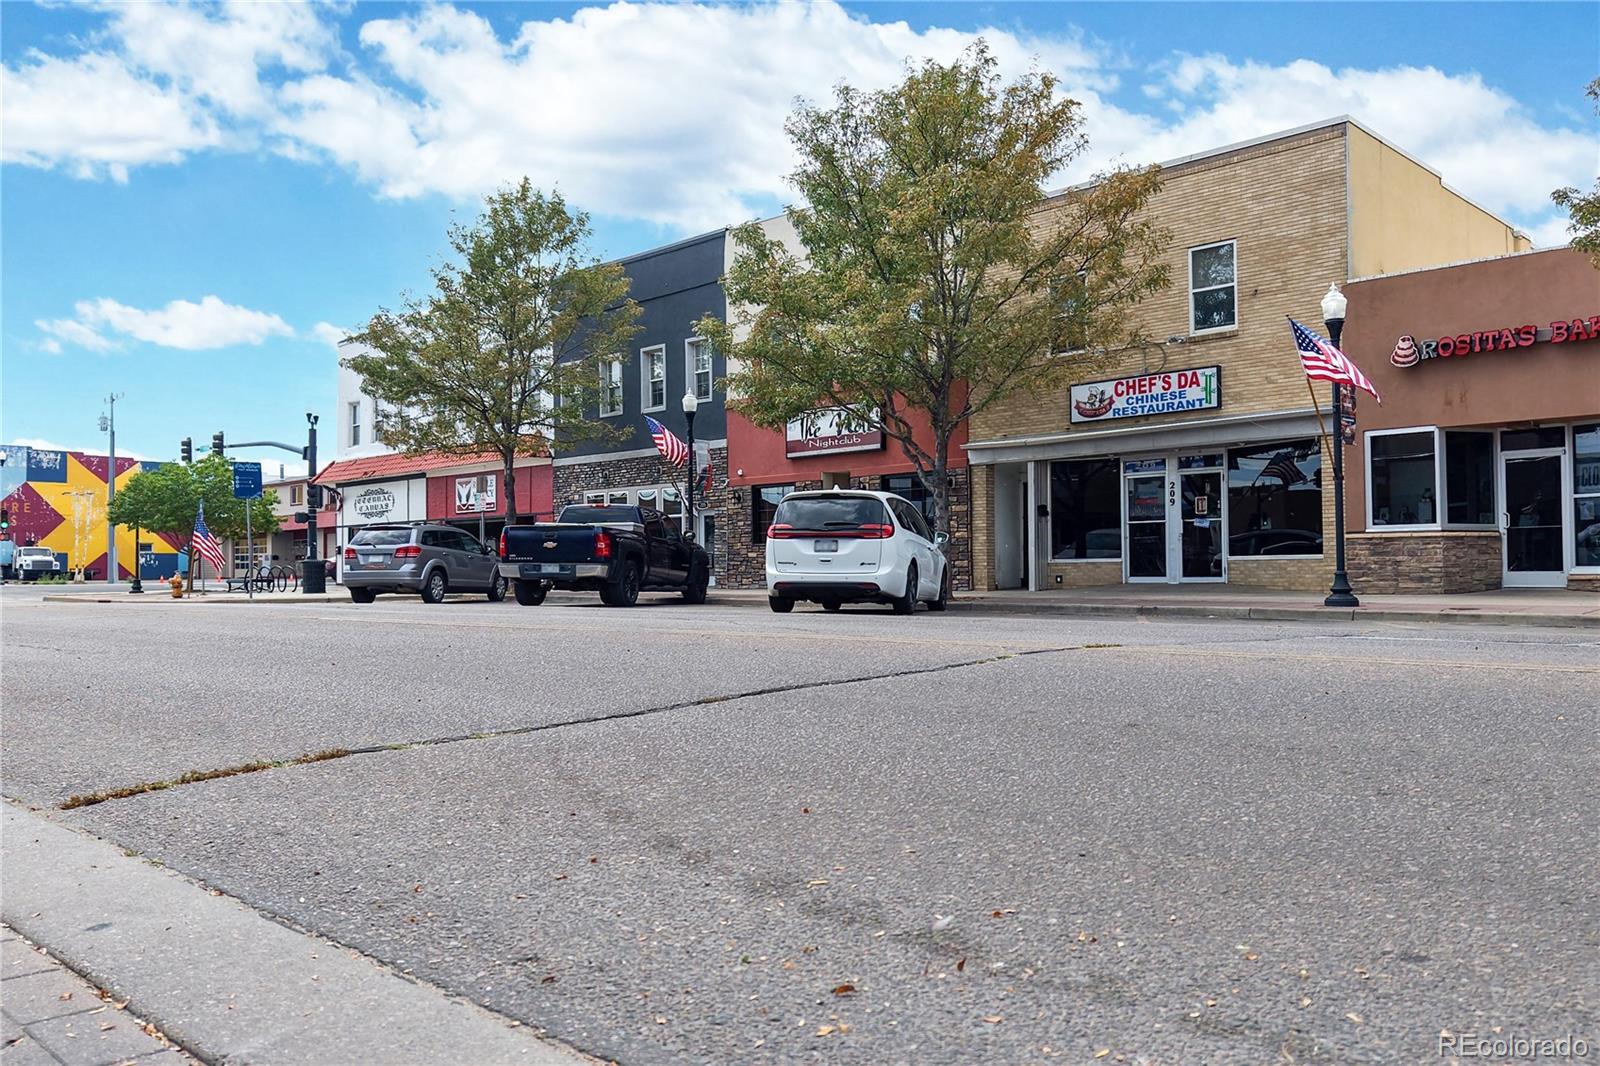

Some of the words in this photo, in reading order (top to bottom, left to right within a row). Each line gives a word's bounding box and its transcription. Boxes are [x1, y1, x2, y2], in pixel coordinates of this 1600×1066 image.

[1421, 326, 1537, 360] ROSITA'S
[1114, 374, 1172, 397] CHEF'S
[1177, 371, 1201, 389] DA
[1113, 398, 1205, 416] RESTAURANT
[1126, 390, 1187, 405] CHINESE
[790, 412, 820, 442] The
[809, 435, 861, 448] Nightclub
